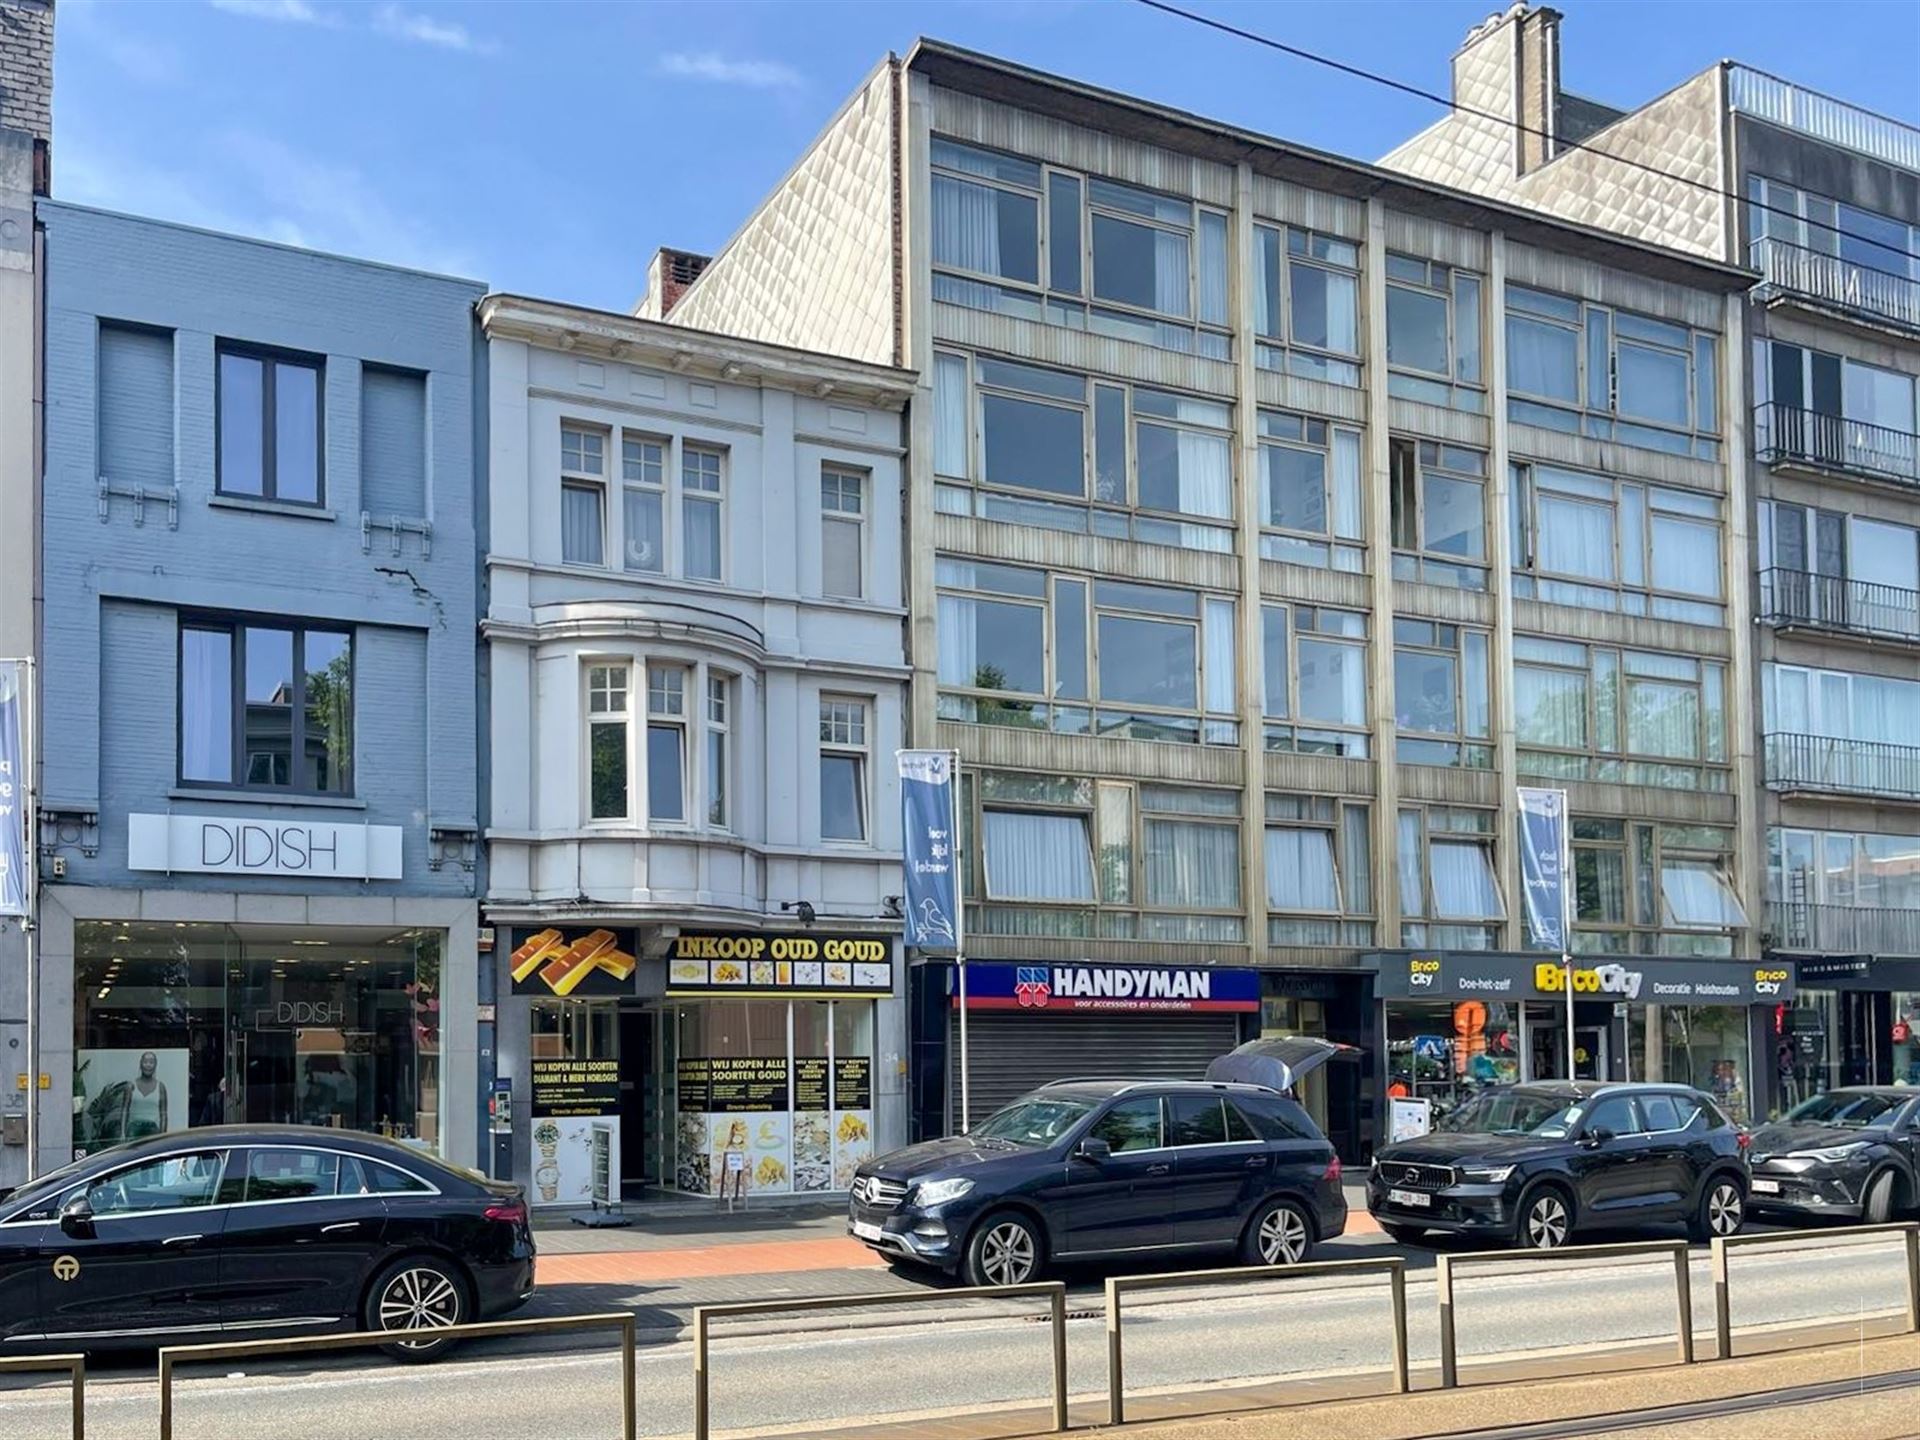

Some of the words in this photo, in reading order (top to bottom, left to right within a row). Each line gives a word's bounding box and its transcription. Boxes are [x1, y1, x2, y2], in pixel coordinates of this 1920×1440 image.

[203, 824, 336, 870] DIDISH
[676, 937, 765, 959] INKOOP
[770, 938, 818, 960] OUD
[824, 940, 885, 961] GOUD
[1411, 960, 1439, 973] Brico
[1411, 973, 1433, 987] City
[1755, 969, 1787, 981] Brico
[1054, 968, 1210, 999] HANDYMAN
[1459, 978, 1511, 991] Doe-het-zelf
[1653, 982, 1691, 994] Decoratie
[1695, 983, 1740, 995] Huishouden
[1755, 981, 1780, 994] City
[1093, 1000, 1138, 1008] accessoires
[1151, 1001, 1192, 1009] onderdelen
[278, 1002, 343, 1023] DIDISH
[534, 1063, 547, 1072] WIJ
[548, 1062, 571, 1072] KOPEN
[571, 1062, 587, 1071] ALLE
[588, 1062, 618, 1071] SOORTEN
[712, 1060, 729, 1069] WIJ
[732, 1060, 763, 1069] KOPEN
[766, 1060, 786, 1068] ALLE
[534, 1074, 561, 1083] DIAMANT
[712, 1071, 755, 1080] SOORTEN
[758, 1071, 786, 1079] GOUD
